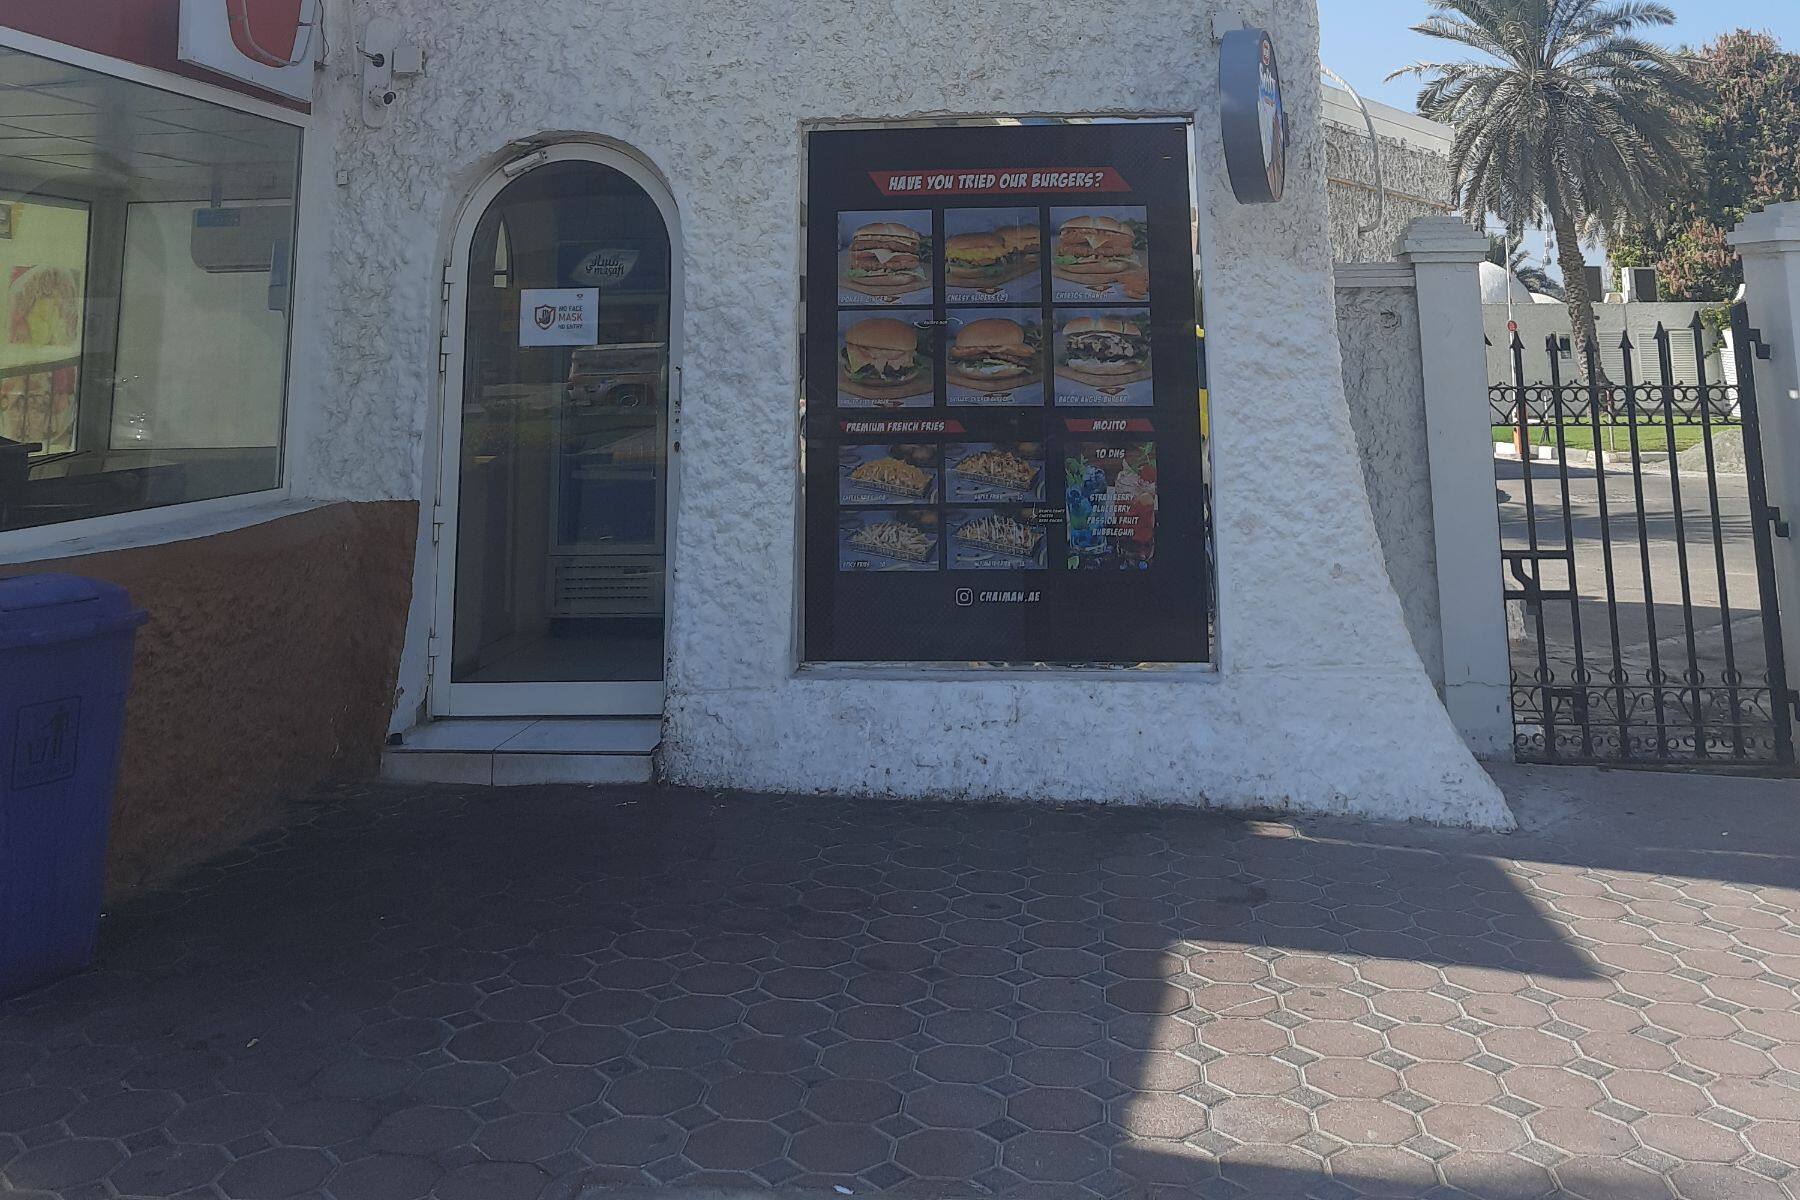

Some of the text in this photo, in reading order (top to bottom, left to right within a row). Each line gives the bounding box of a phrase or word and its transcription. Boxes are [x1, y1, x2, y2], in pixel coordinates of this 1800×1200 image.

[888, 172, 1104, 191] HAVE YOU TRIED OUR BURGERS?
[558, 313, 583, 322] MASK
[845, 421, 945, 433] PREMIUM FRENCH FRIES
[1092, 420, 1127, 431] MOJITO
[1087, 516, 1140, 525] PASSION FRUIT
[1091, 528, 1135, 537] BUBBLEGUM
[979, 591, 1041, 603] CHAIMAN.AE
